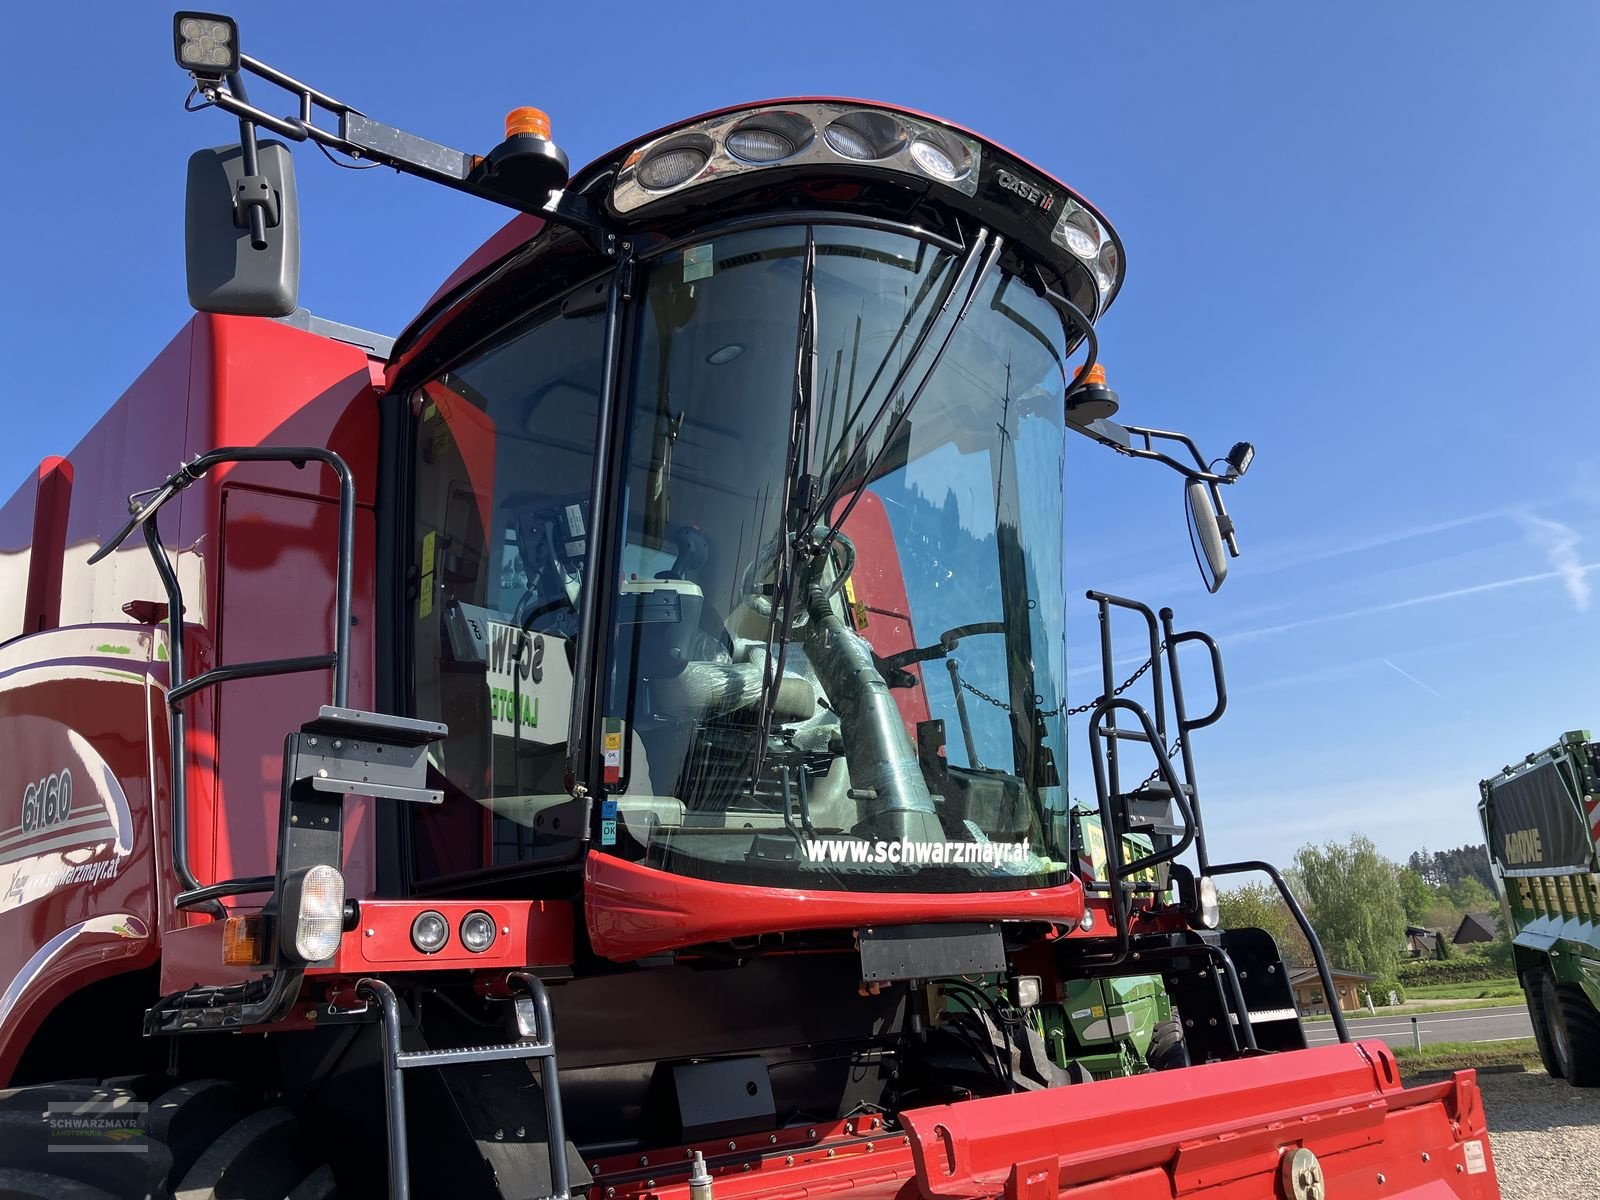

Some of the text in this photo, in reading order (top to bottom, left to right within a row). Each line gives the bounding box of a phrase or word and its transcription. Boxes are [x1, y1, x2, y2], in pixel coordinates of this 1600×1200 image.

[997, 170, 1040, 205] CASE
[22, 767, 73, 836] 6160
[604, 826, 616, 835] OK
[806, 836, 1030, 868] www.schwarzmayr.at
